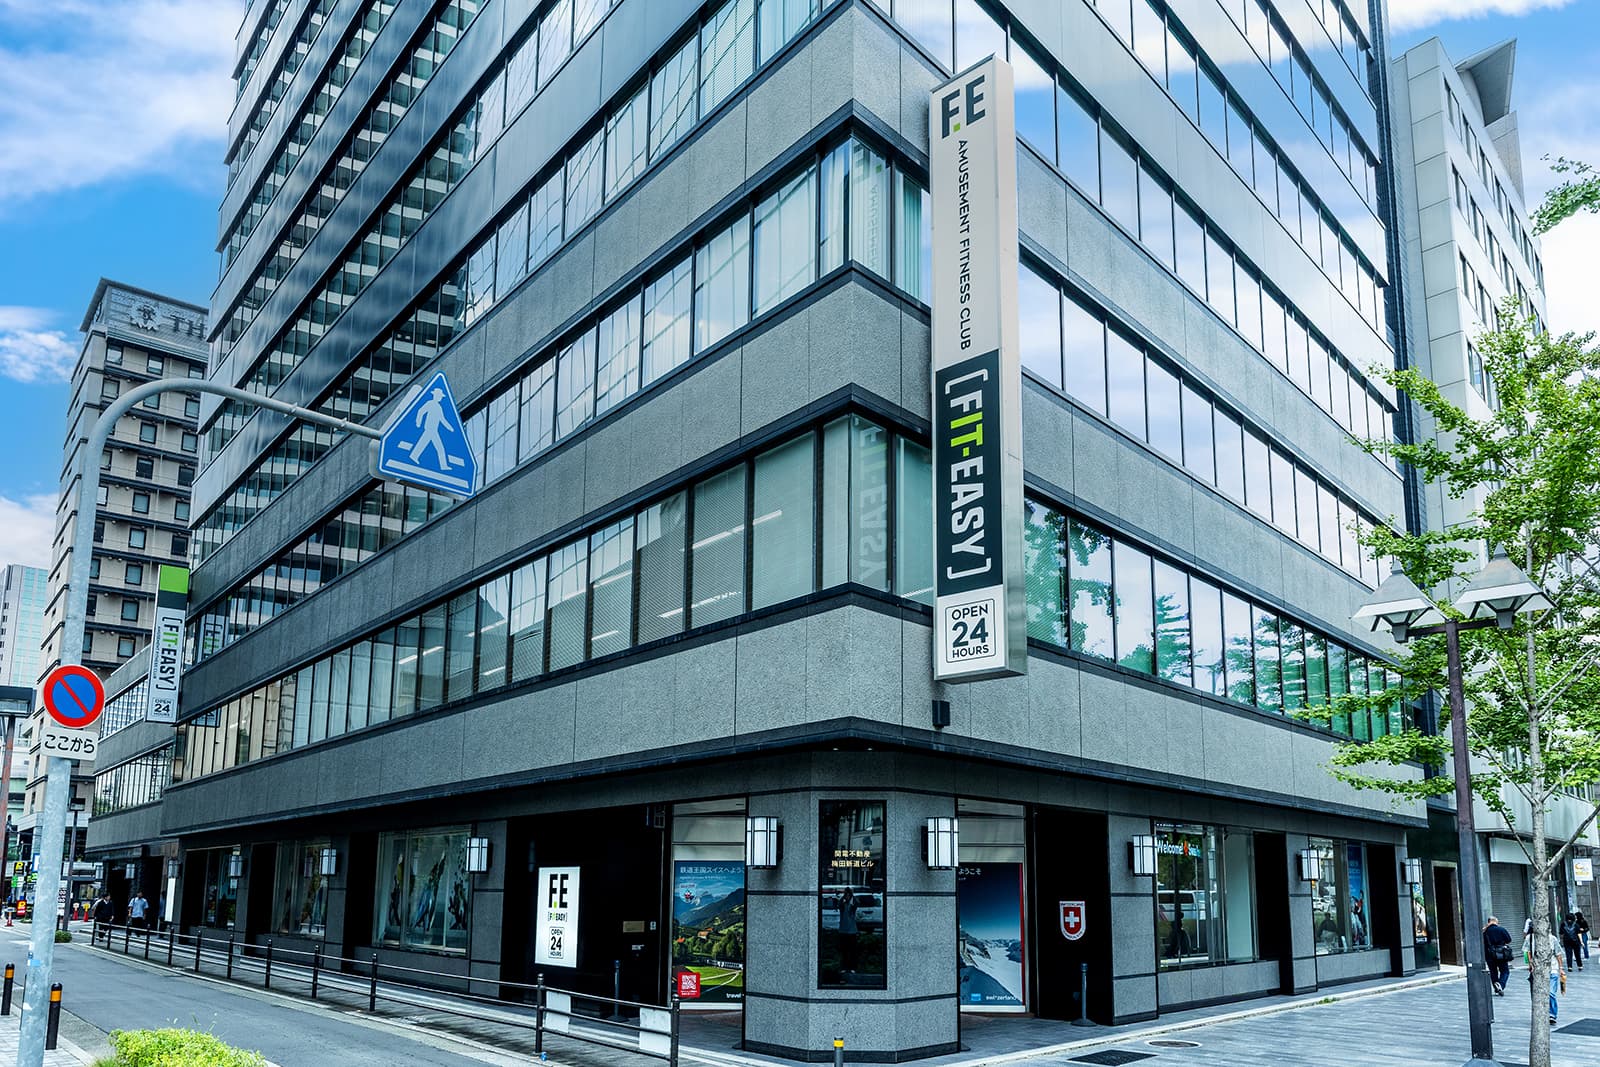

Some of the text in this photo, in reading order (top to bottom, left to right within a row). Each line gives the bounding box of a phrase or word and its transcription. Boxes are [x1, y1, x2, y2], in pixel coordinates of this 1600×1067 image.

[958, 140, 971, 350] AMUSEMENT FITNESS CLUB
[951, 603, 988, 620] OPEN
[951, 617, 989, 648] 24
[952, 645, 989, 658] HOURS
[154, 704, 170, 713] 24
[45, 734, 95, 754] ここから
[550, 936, 562, 950] 24
